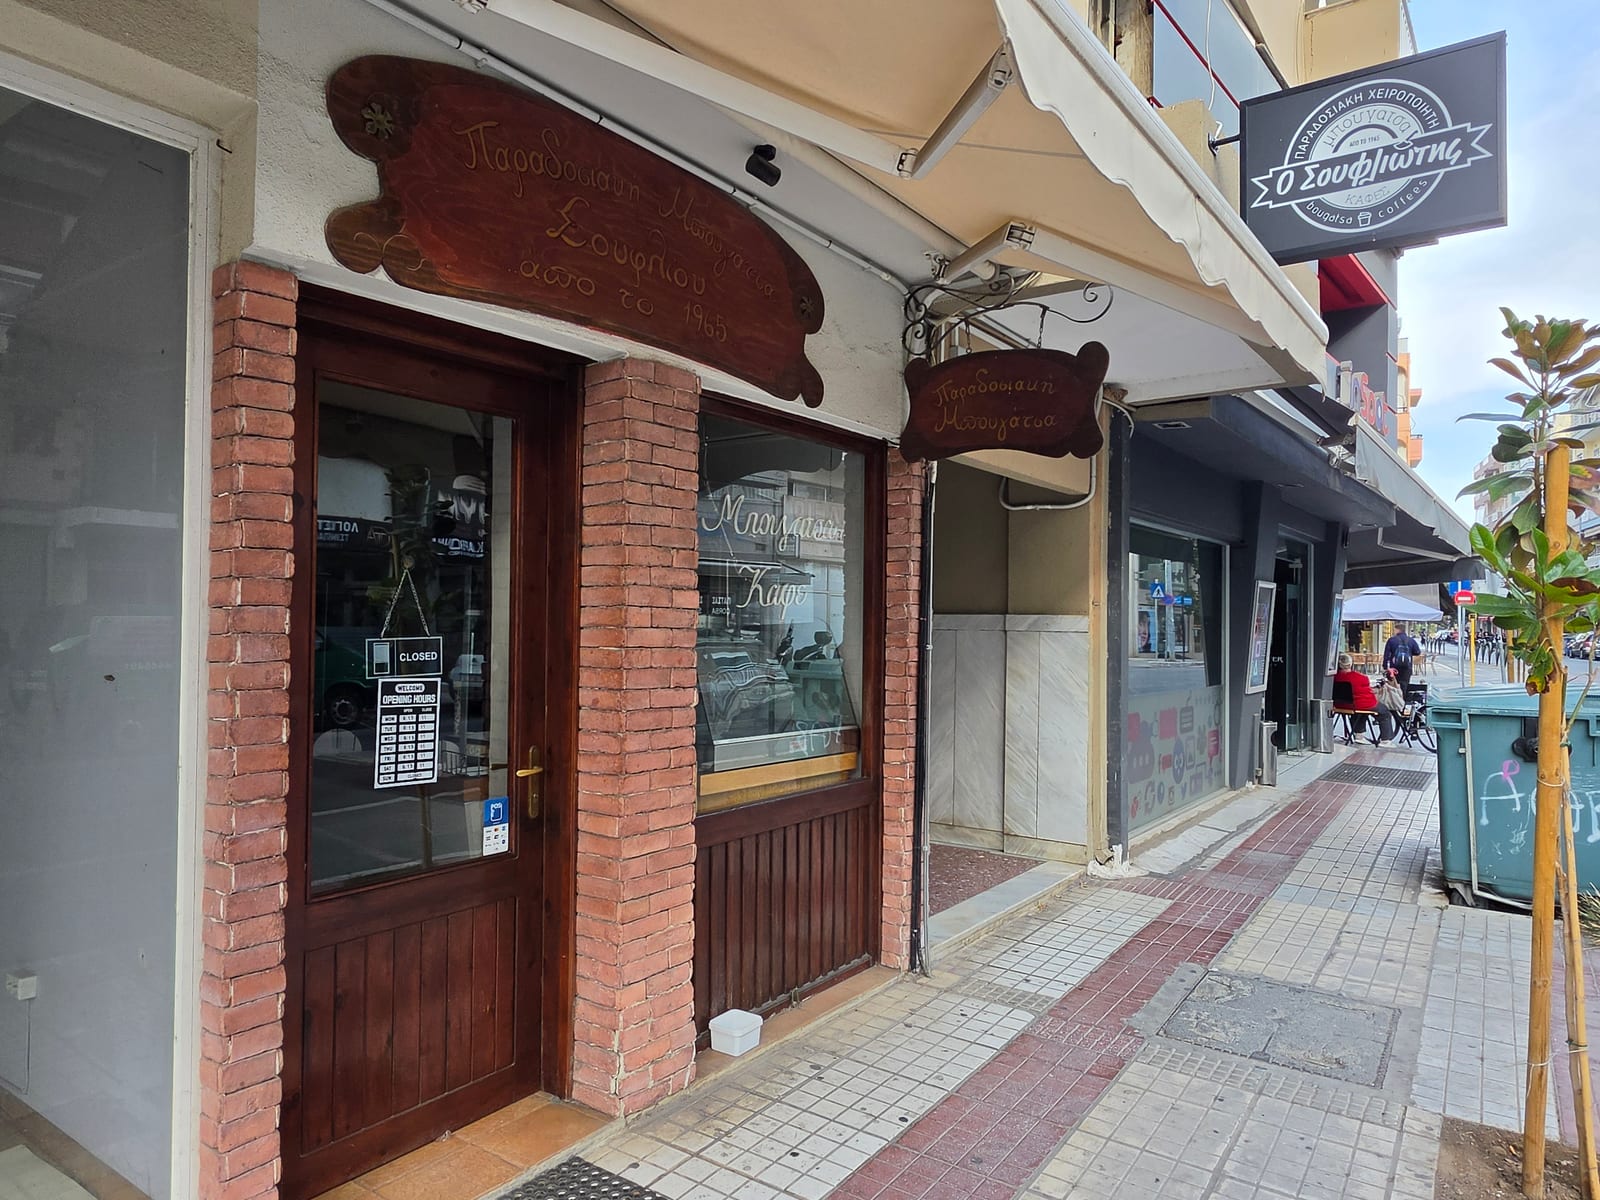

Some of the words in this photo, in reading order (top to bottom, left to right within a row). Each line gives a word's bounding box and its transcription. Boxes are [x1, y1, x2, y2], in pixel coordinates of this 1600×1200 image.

[1294, 92, 1363, 159] ΠΑΡΑΔΟΣΙΑΚΗ
[1368, 88, 1440, 129] ΧΕΙΡΟΠΟΙΗΤΗ
[1276, 169, 1295, 196] Ο
[1306, 200, 1353, 225] bougatsa
[1378, 179, 1428, 218] coffees
[684, 300, 728, 344] 1965
[399, 652, 438, 662] CLOSED
[382, 695, 412, 704] OPENING
[413, 694, 436, 703] HOURS
